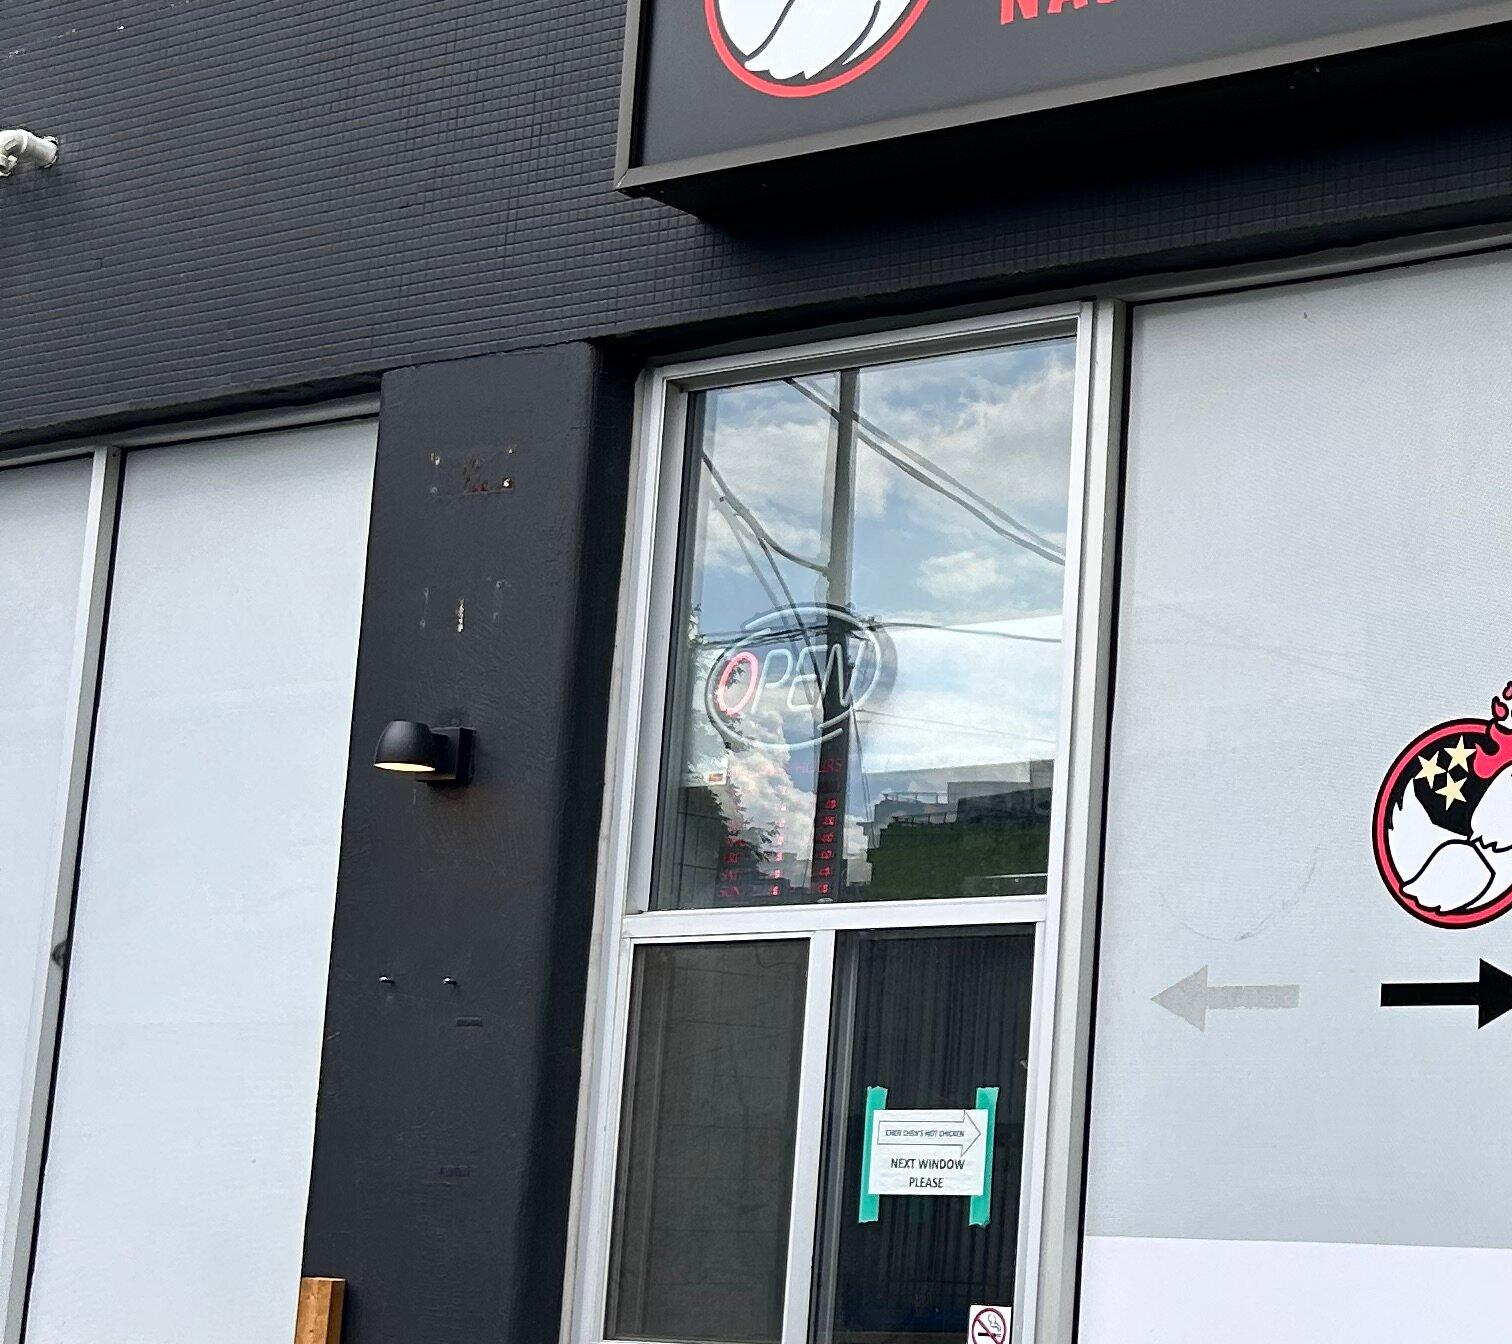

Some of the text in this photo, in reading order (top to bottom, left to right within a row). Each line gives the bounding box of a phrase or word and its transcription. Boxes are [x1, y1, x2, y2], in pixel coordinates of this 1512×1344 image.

[715, 642, 867, 717] OPEN
[890, 1158, 966, 1170] NEXT WINDOW
[908, 1177, 944, 1188] PLEASE
